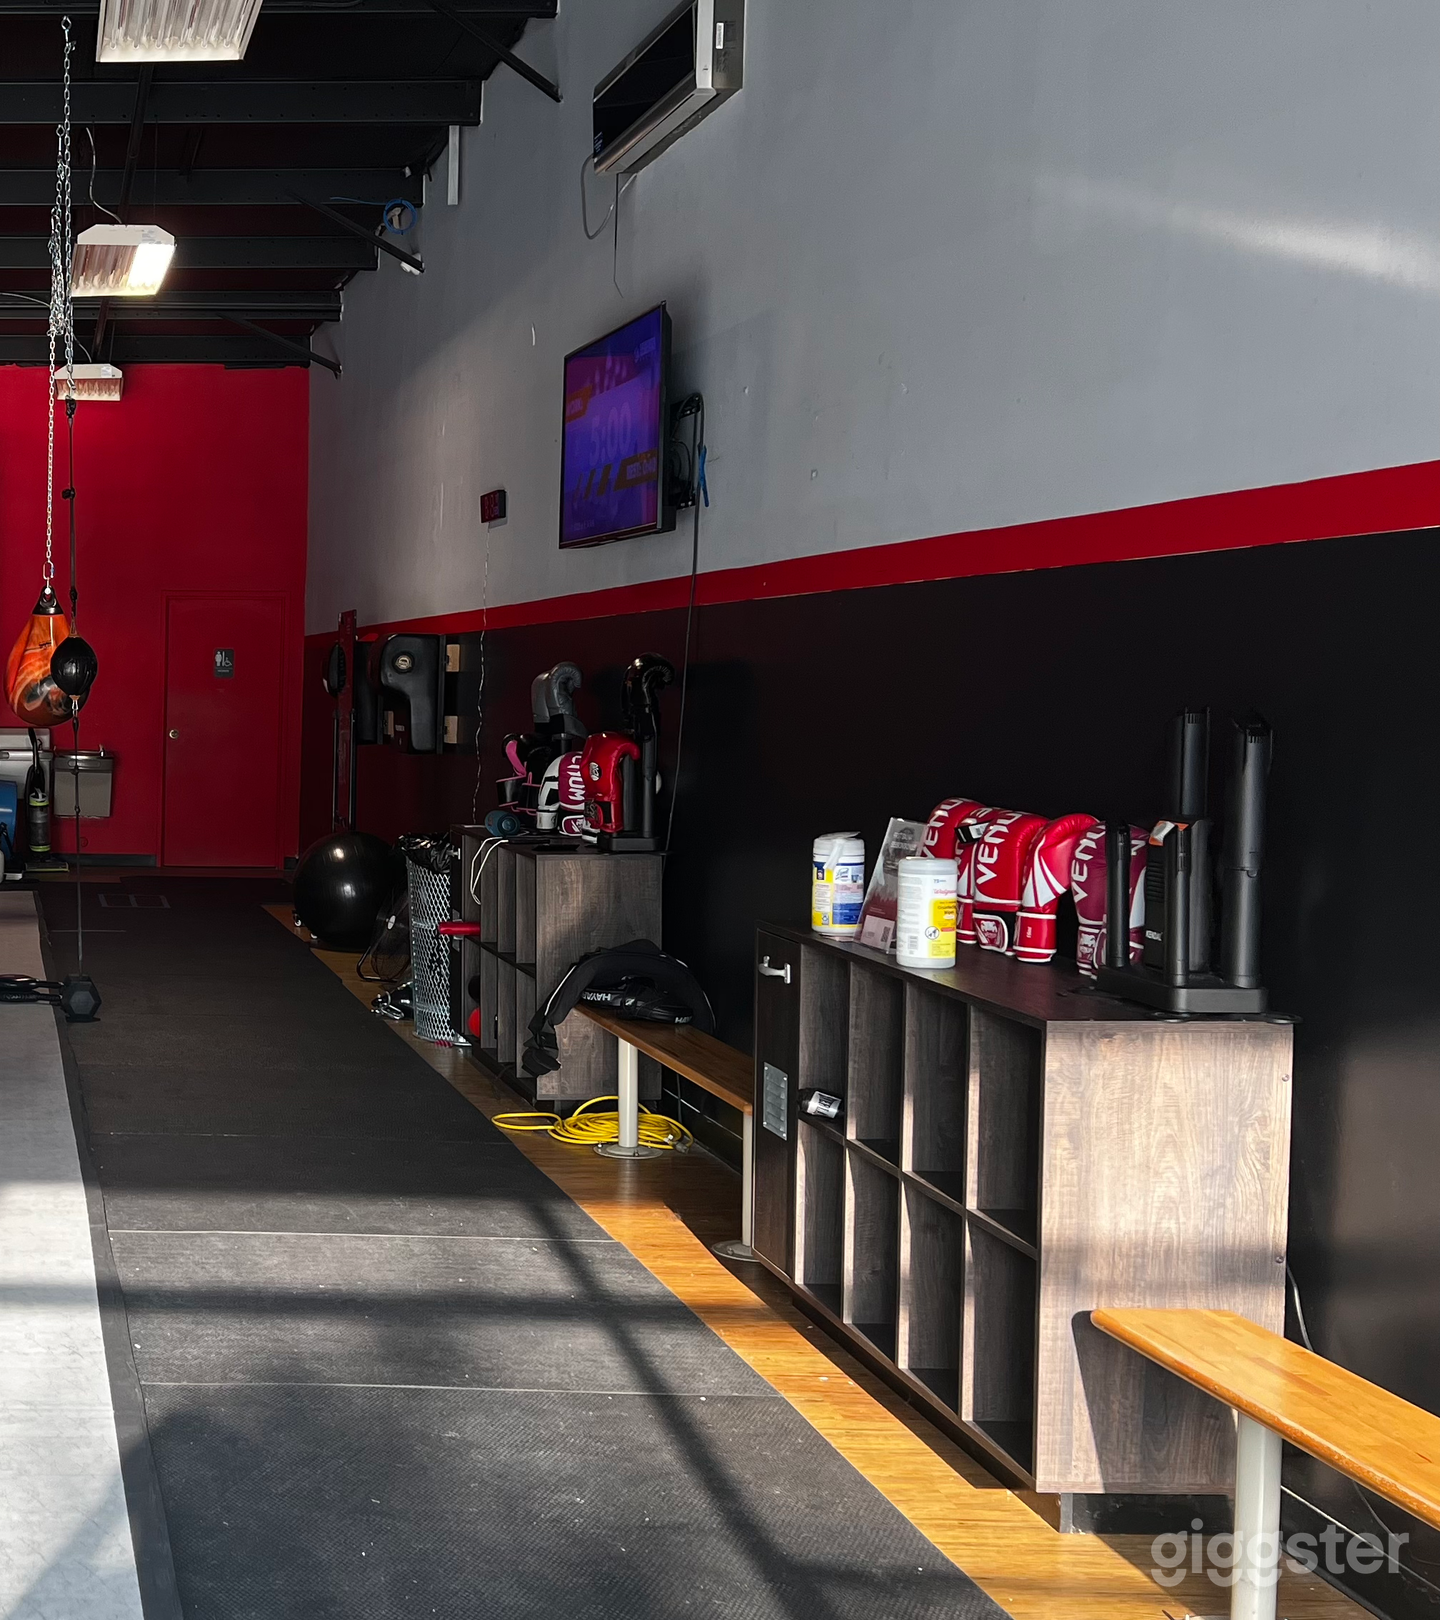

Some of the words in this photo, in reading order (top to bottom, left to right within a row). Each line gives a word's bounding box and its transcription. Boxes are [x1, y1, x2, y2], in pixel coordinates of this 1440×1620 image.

[922, 798, 965, 859] VENU
[975, 810, 1024, 885] VENU
[1071, 824, 1107, 903] VENU
